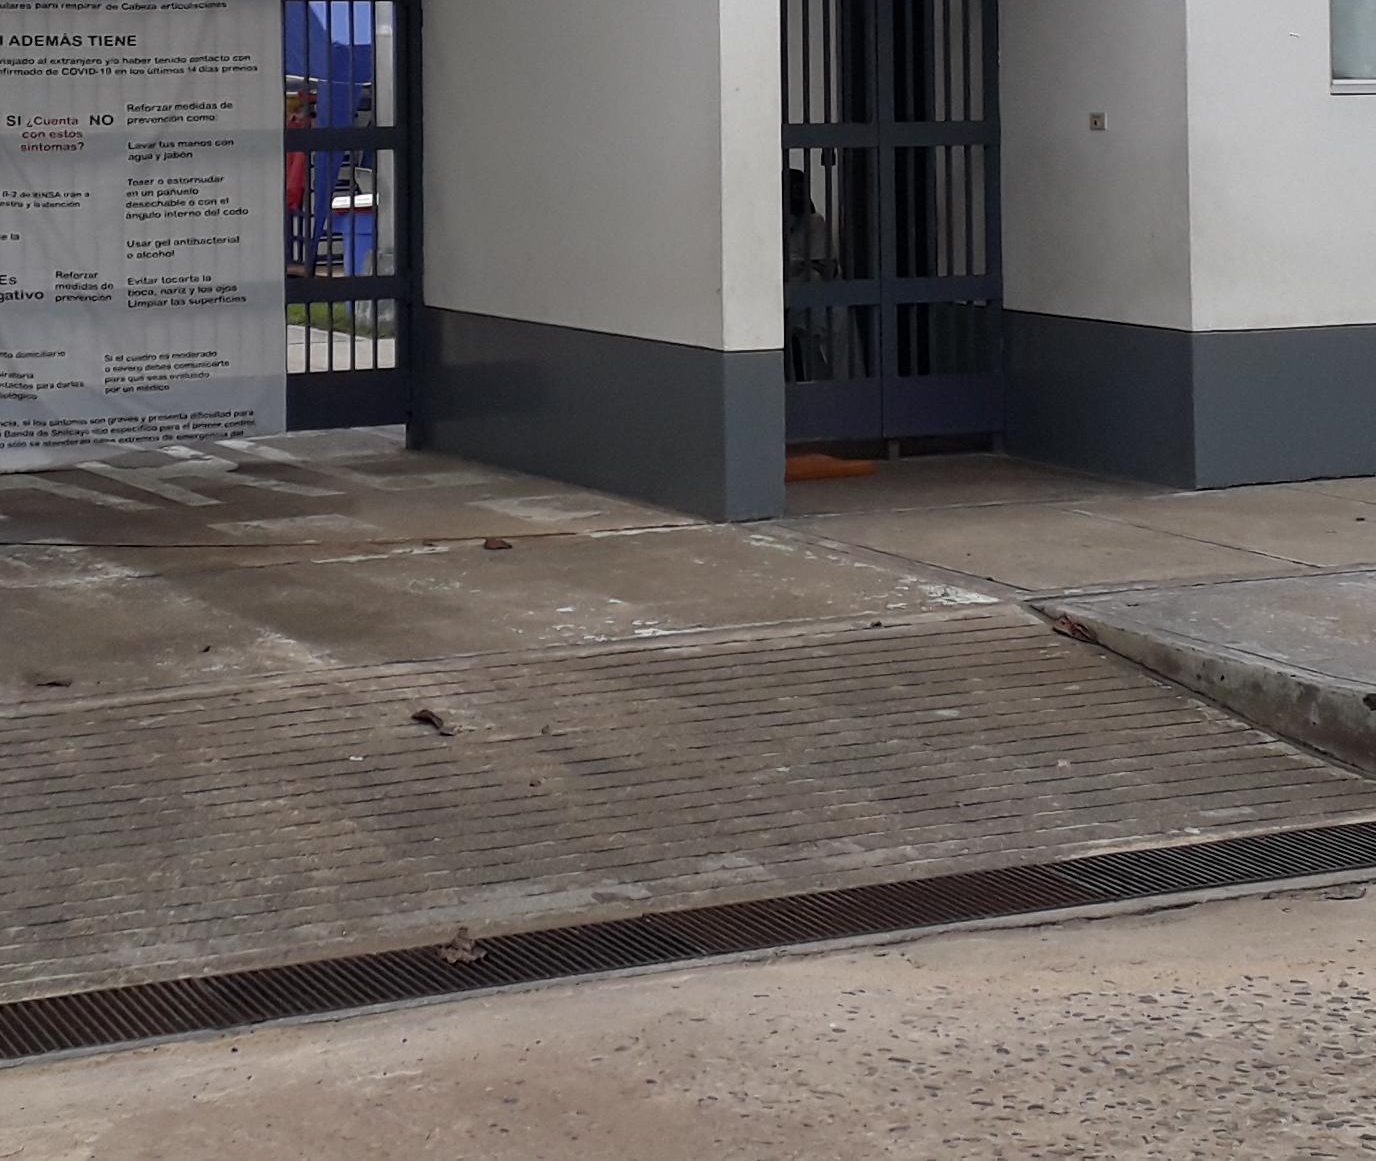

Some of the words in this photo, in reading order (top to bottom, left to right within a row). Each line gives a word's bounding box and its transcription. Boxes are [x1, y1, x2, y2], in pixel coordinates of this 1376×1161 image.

[9, 33, 82, 46] ADEMÁS
[88, 35, 136, 46] TIENE
[7, 116, 21, 126] SI
[90, 115, 113, 125] NO
[49, 130, 82, 138] estos
